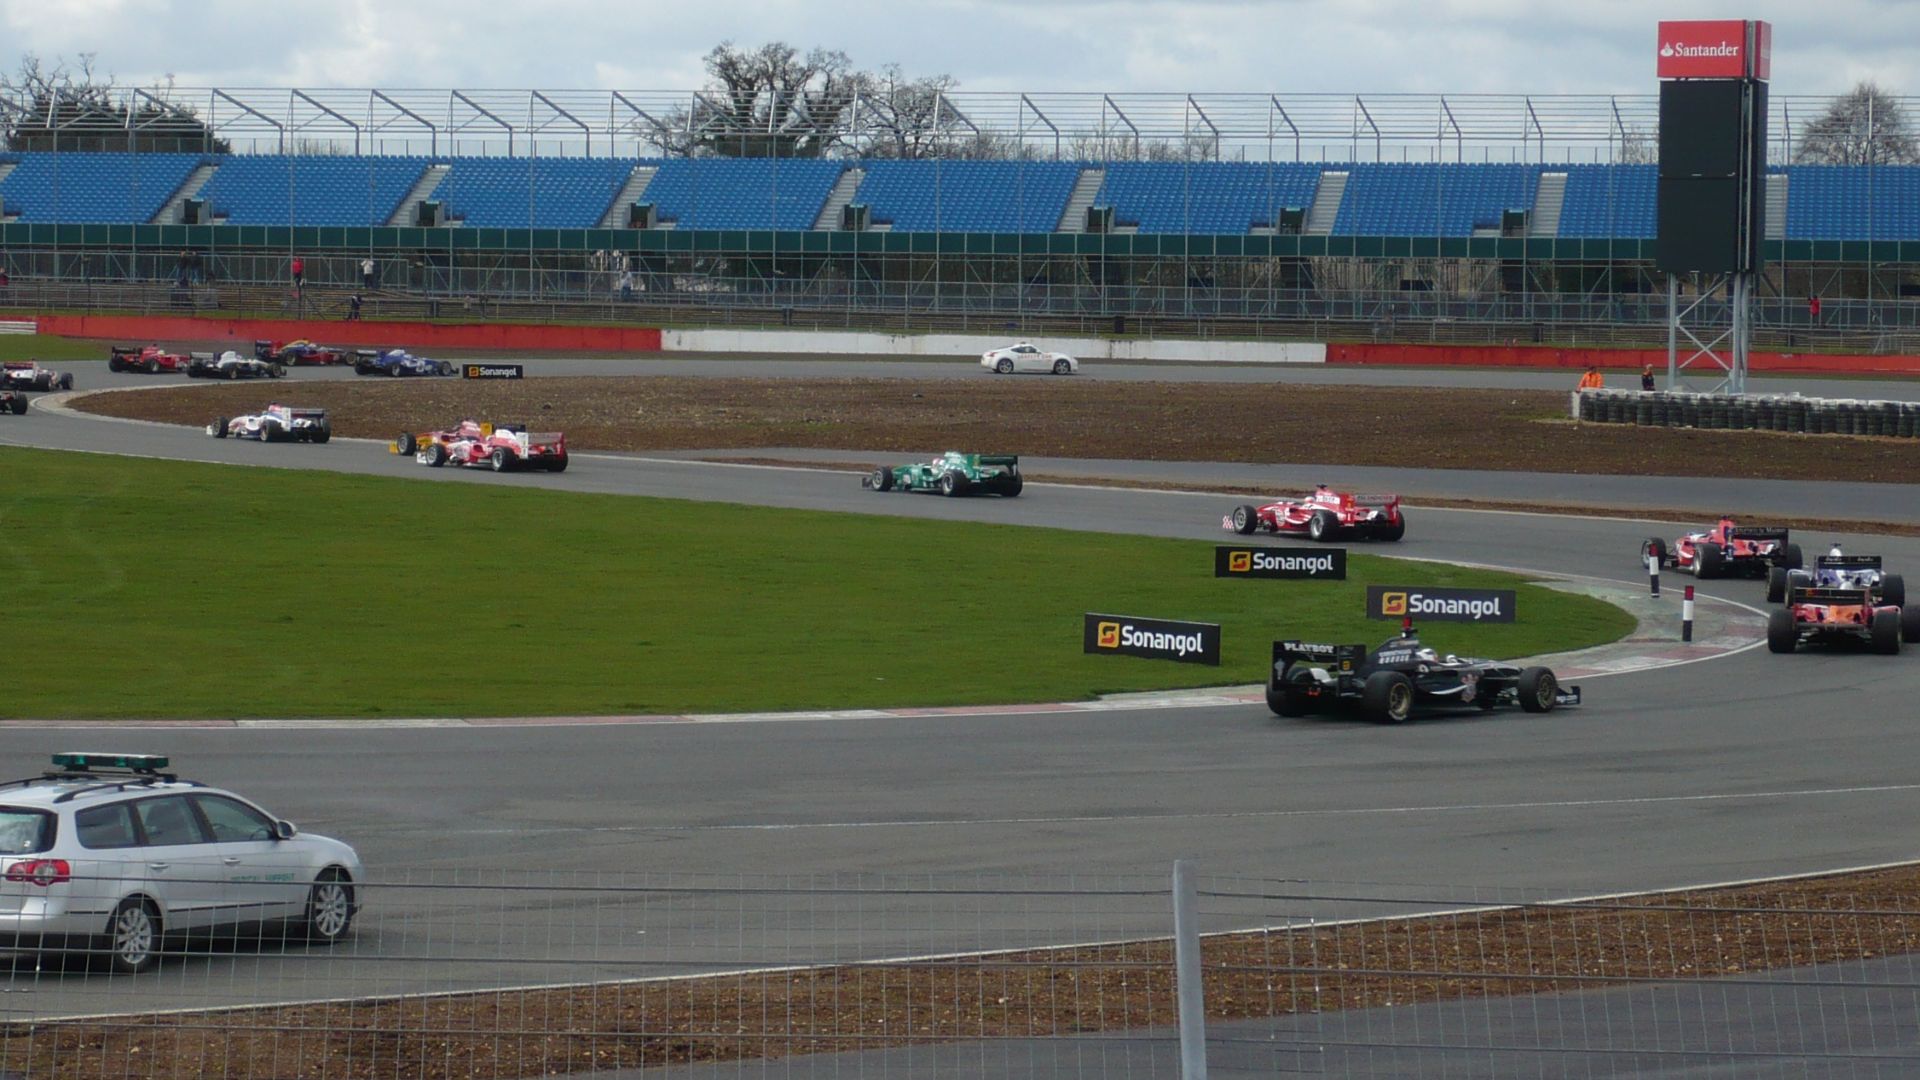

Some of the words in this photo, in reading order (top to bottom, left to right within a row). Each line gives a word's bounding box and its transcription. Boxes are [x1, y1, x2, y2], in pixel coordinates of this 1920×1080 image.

[1675, 41, 1739, 57] Santander
[479, 366, 517, 378] Sonangol
[1252, 552, 1333, 575] Sonangol
[1409, 594, 1501, 620] Sonangol
[1121, 625, 1203, 656] Sonangol
[1284, 643, 1334, 654] PLAYBOY
